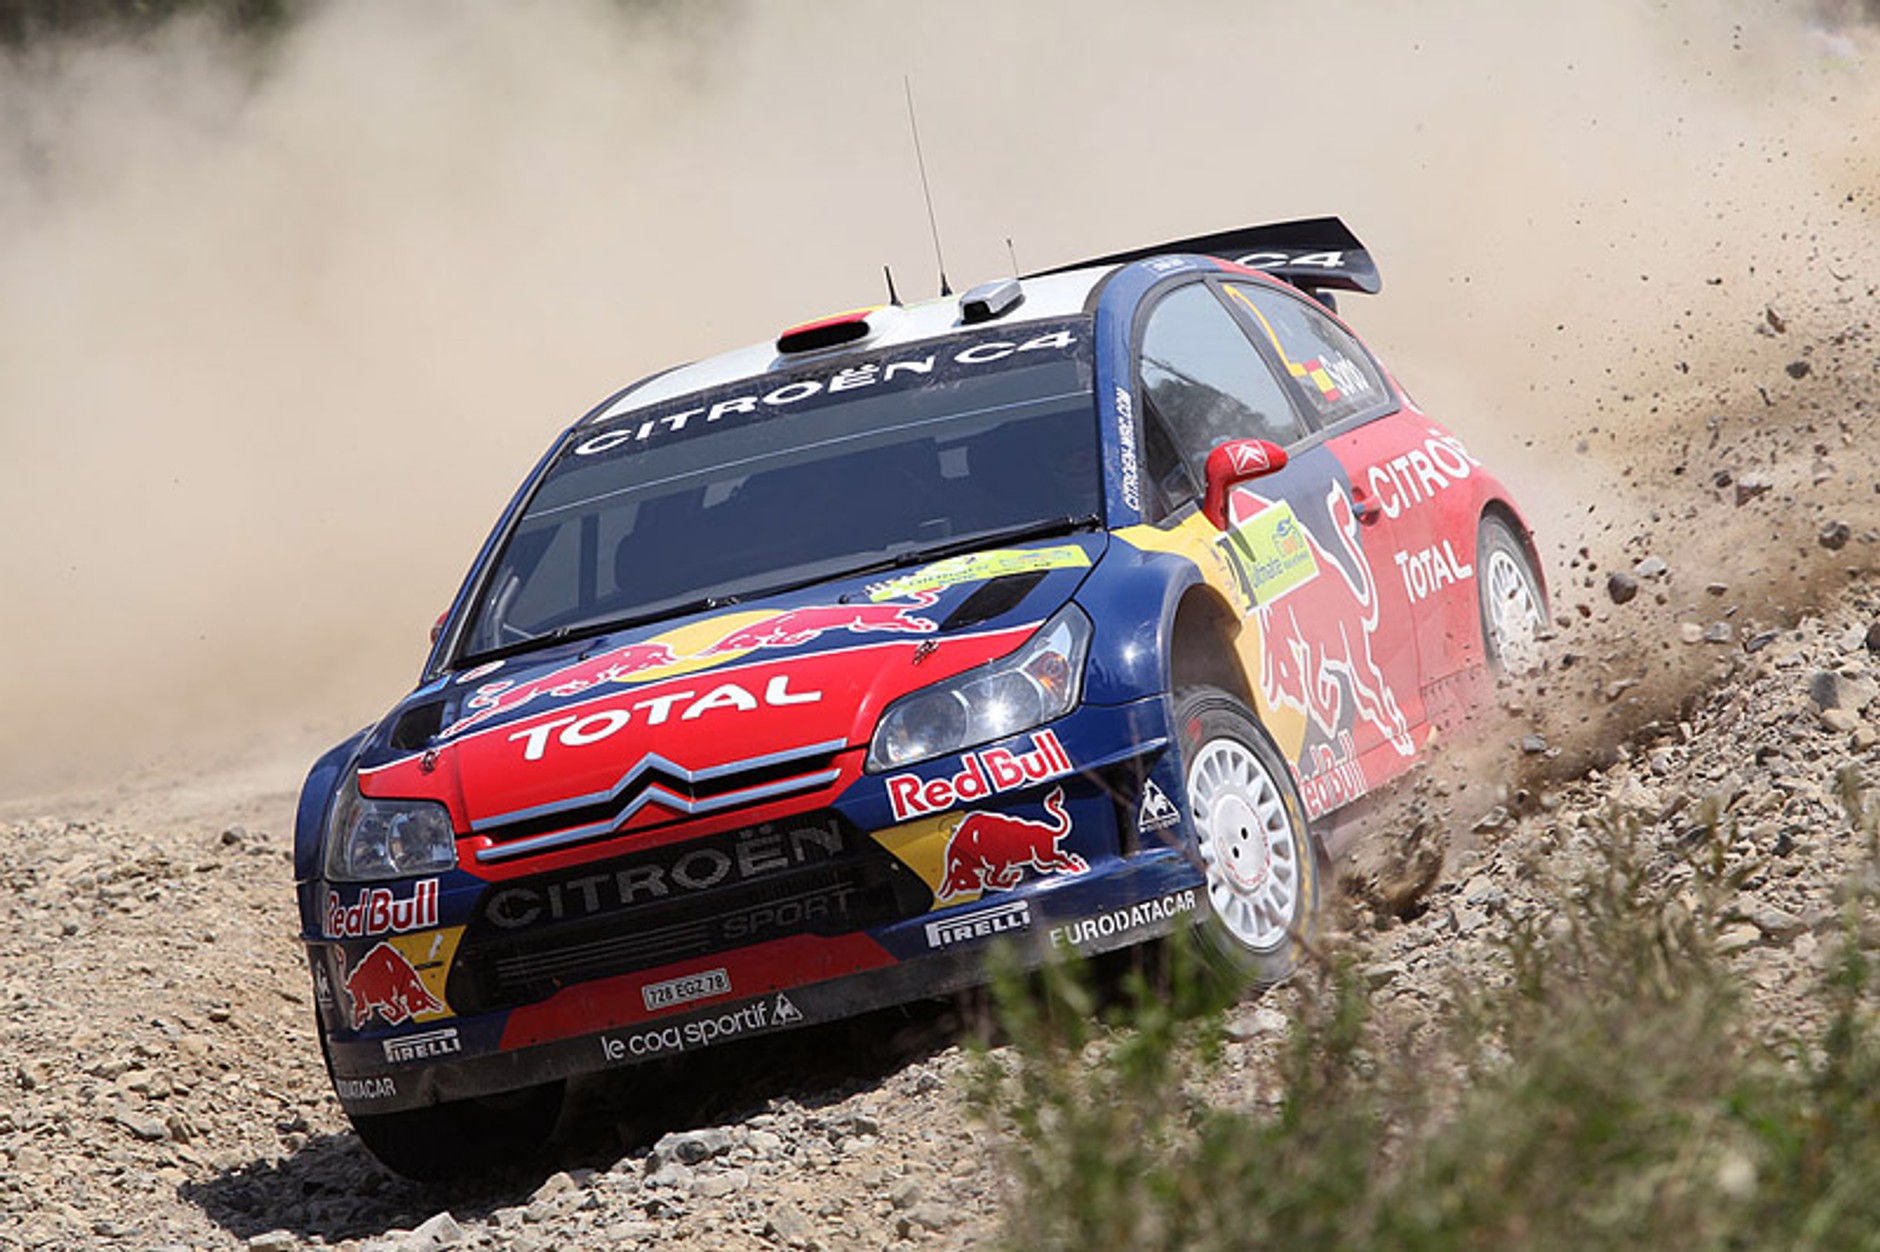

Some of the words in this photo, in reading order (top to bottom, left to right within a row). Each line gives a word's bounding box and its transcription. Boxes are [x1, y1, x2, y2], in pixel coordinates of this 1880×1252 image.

[1234, 251, 1345, 269] C4
[574, 355, 936, 455] CITROËN
[953, 330, 1078, 364] C4
[507, 675, 823, 761] TOTAL
[885, 751, 989, 822] Red
[980, 728, 1074, 791] Bull
[484, 819, 844, 929] CITROËN
[323, 888, 369, 938] Red
[367, 878, 439, 935] Bull
[723, 890, 856, 939] SPORT
[926, 901, 1032, 948] PIRELLI
[1050, 891, 1196, 949] EURODATACAR
[383, 1028, 462, 1063] PIRELLI
[601, 1036, 626, 1061] le
[629, 1026, 684, 1055] coq
[684, 1001, 768, 1046] sportif
